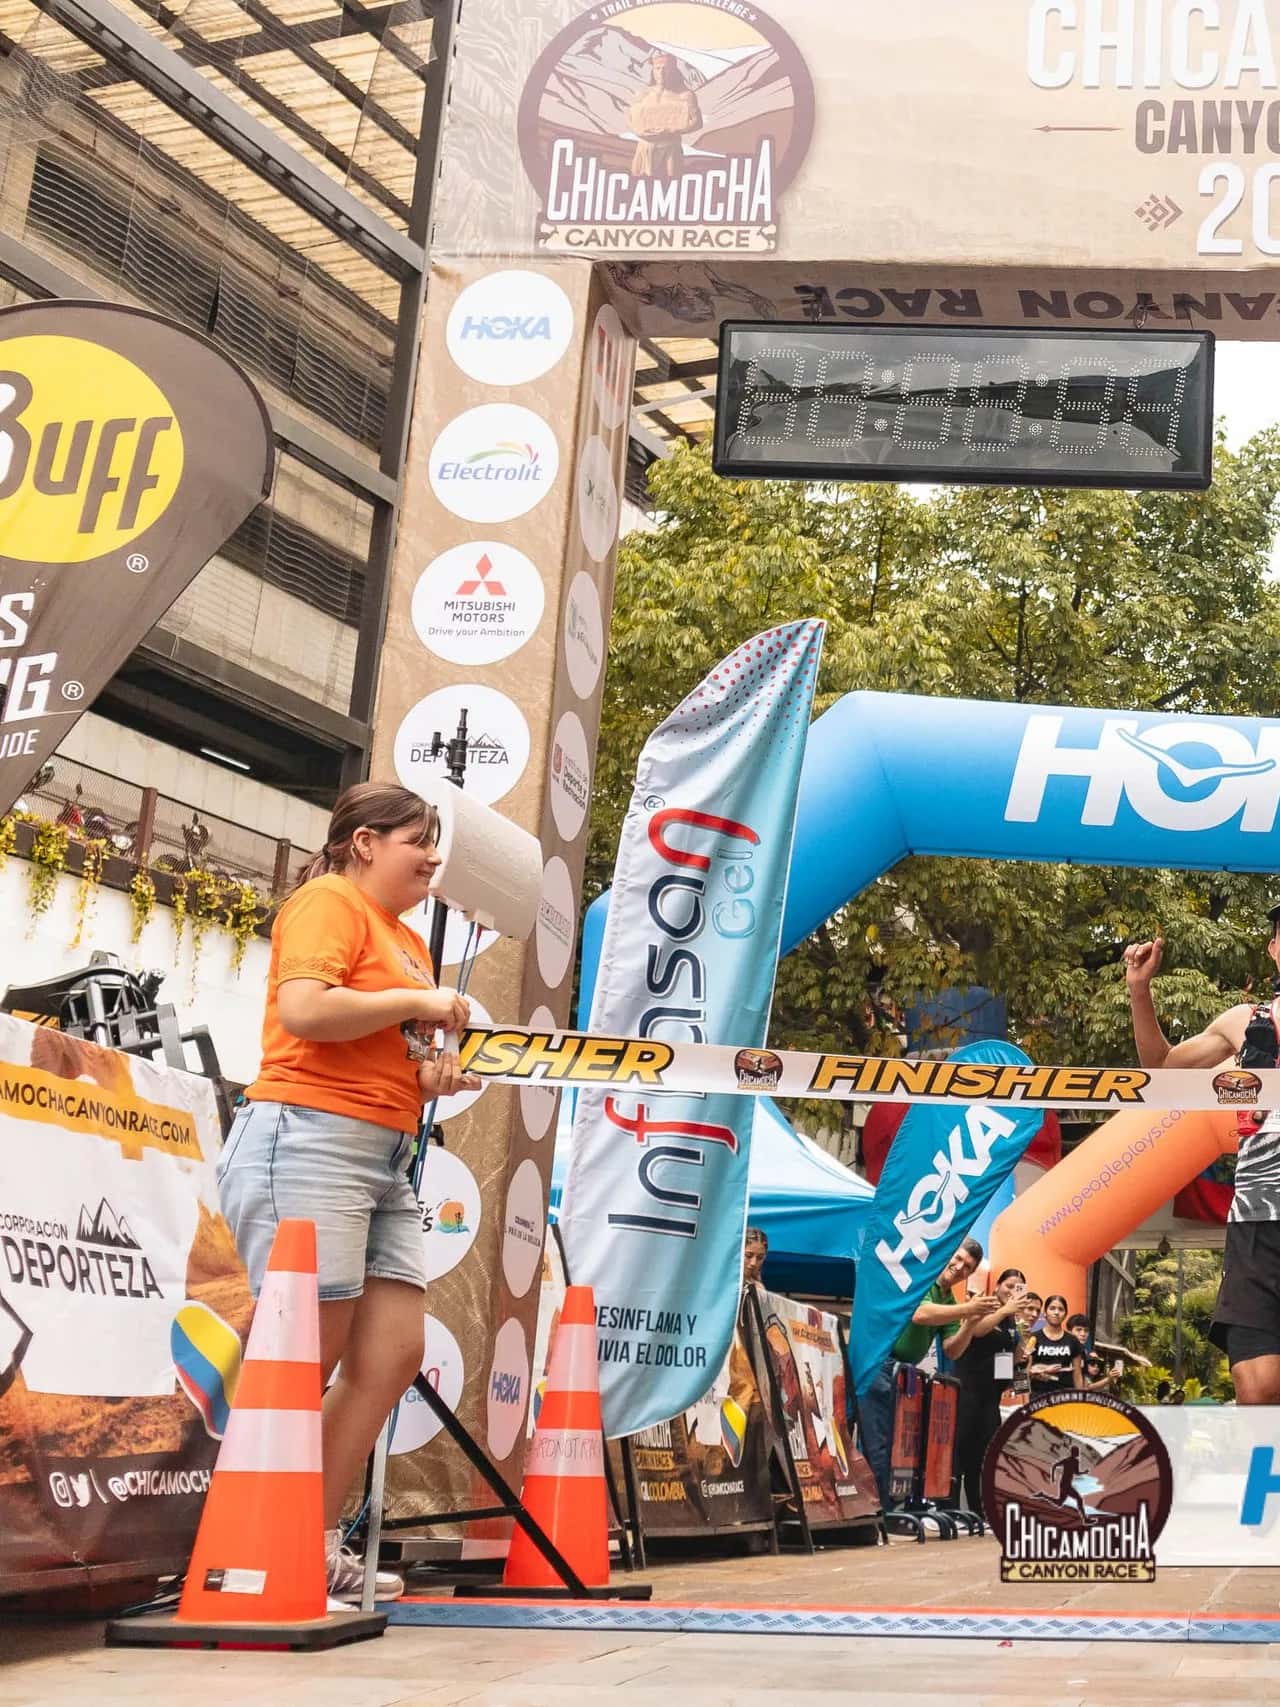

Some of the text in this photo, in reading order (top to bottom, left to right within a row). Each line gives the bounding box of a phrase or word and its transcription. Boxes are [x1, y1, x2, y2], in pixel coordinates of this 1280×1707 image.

[547, 138, 772, 222] CHICAMOCHA
[565, 229, 750, 248] CANYON RACE
[793, 285, 983, 319] RACE
[460, 315, 552, 341] HOKA
[438, 462, 543, 481] Electrolit
[444, 600, 516, 612] MITSUBISHI
[451, 613, 505, 623] MOTORS
[428, 626, 526, 638] Drive your Ambition
[712, 848, 757, 941] Gel
[808, 1055, 1151, 1103] FINISHER
[0, 1080, 190, 1146] MOCHACANYONRACE.COM
[875, 1104, 1017, 1293] HOKA
[1, 1236, 165, 1300] DEPORTEZA
[594, 1305, 697, 1336] ESINFLAMA Y
[597, 1338, 707, 1368] IVIA EL DOLOR
[1037, 1345, 1071, 1356] HOKA
[108, 1470, 213, 1502] @CHICAMOCH
